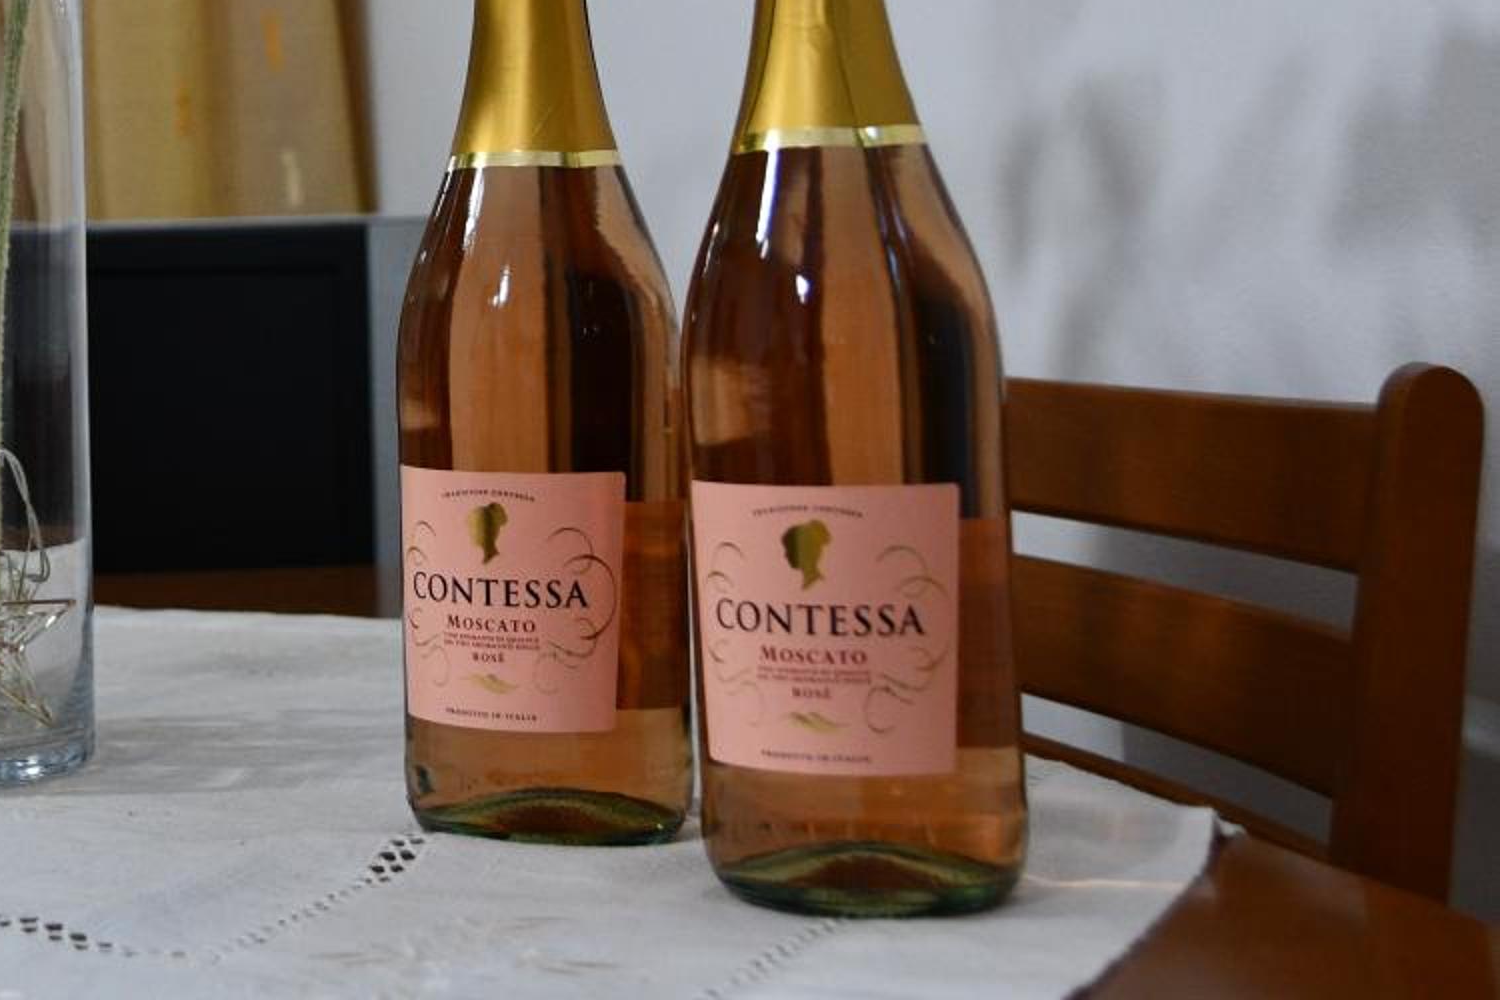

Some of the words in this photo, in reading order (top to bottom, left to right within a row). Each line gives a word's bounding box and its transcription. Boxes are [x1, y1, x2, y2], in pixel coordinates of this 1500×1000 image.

[413, 571, 588, 609] CONTESSA
[447, 614, 537, 633] MOSCATO
[716, 597, 926, 637] CONTESSA
[760, 645, 868, 665] MOSCATO
